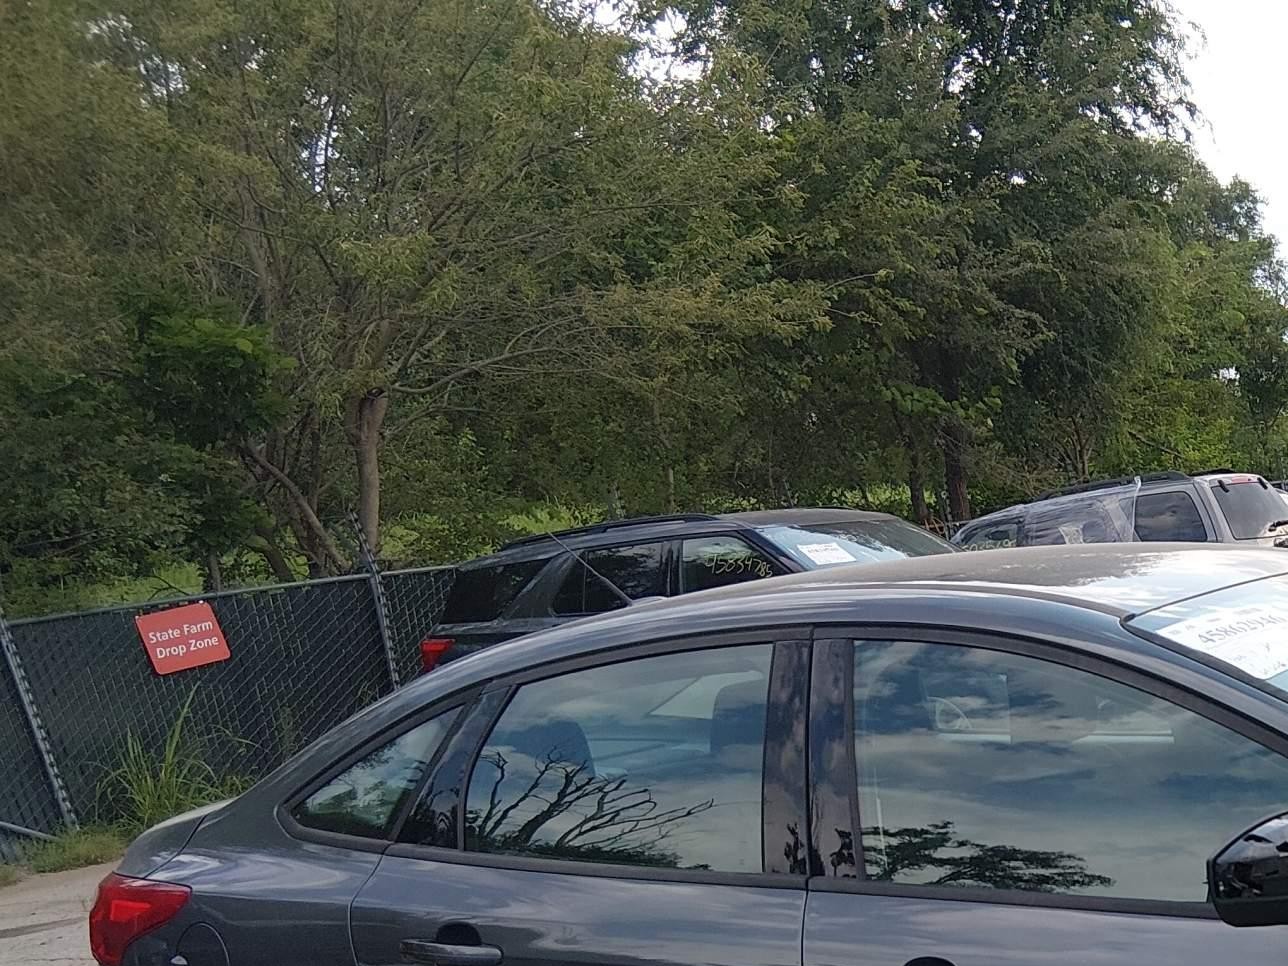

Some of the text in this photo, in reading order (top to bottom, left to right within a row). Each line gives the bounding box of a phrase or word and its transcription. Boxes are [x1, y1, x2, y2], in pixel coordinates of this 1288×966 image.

[148, 621, 213, 644] State Farm
[156, 636, 219, 659] Drop Zone
